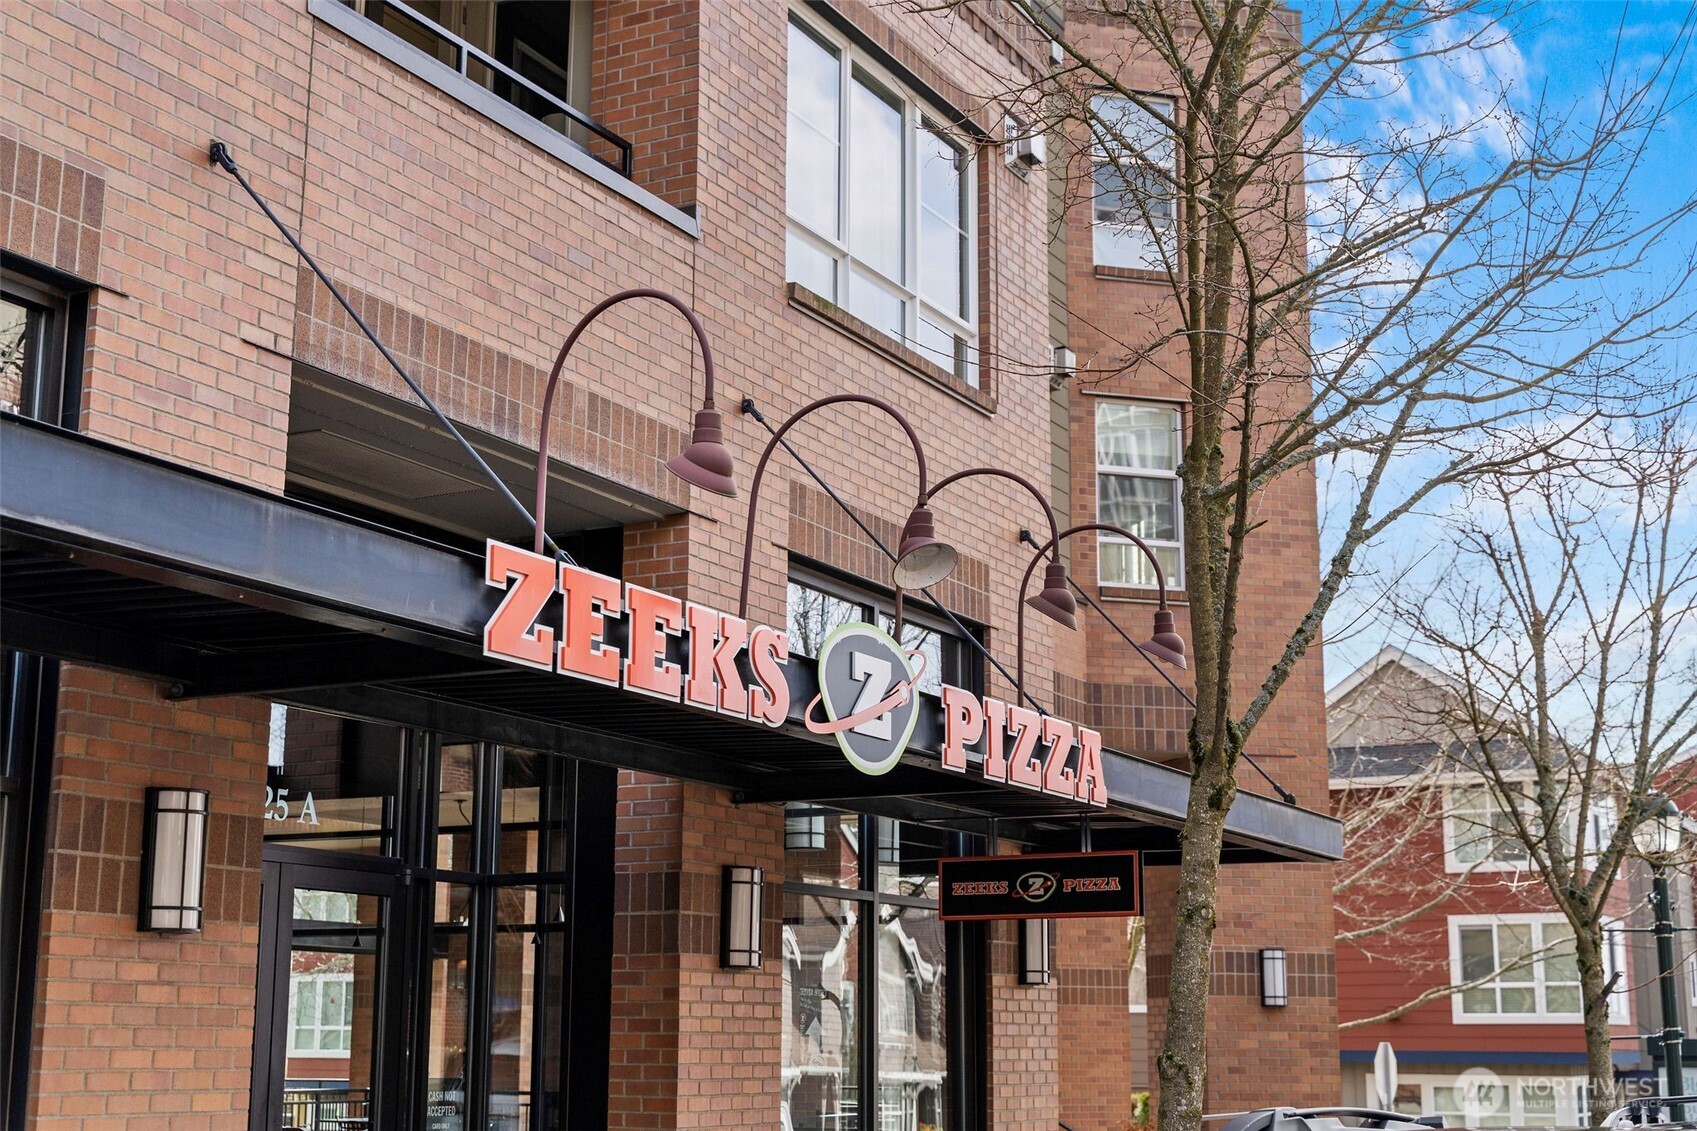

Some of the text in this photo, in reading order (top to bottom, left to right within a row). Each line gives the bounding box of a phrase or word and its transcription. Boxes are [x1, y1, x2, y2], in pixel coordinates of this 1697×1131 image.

[484, 538, 1107, 807] ZEEKS Z PIZZA
[297, 791, 320, 825] A
[952, 877, 1121, 895] ZEEKS Z PIZZA
[428, 1091, 456, 1102] CASH NOT
[427, 1105, 456, 1117] ACCEPTED
